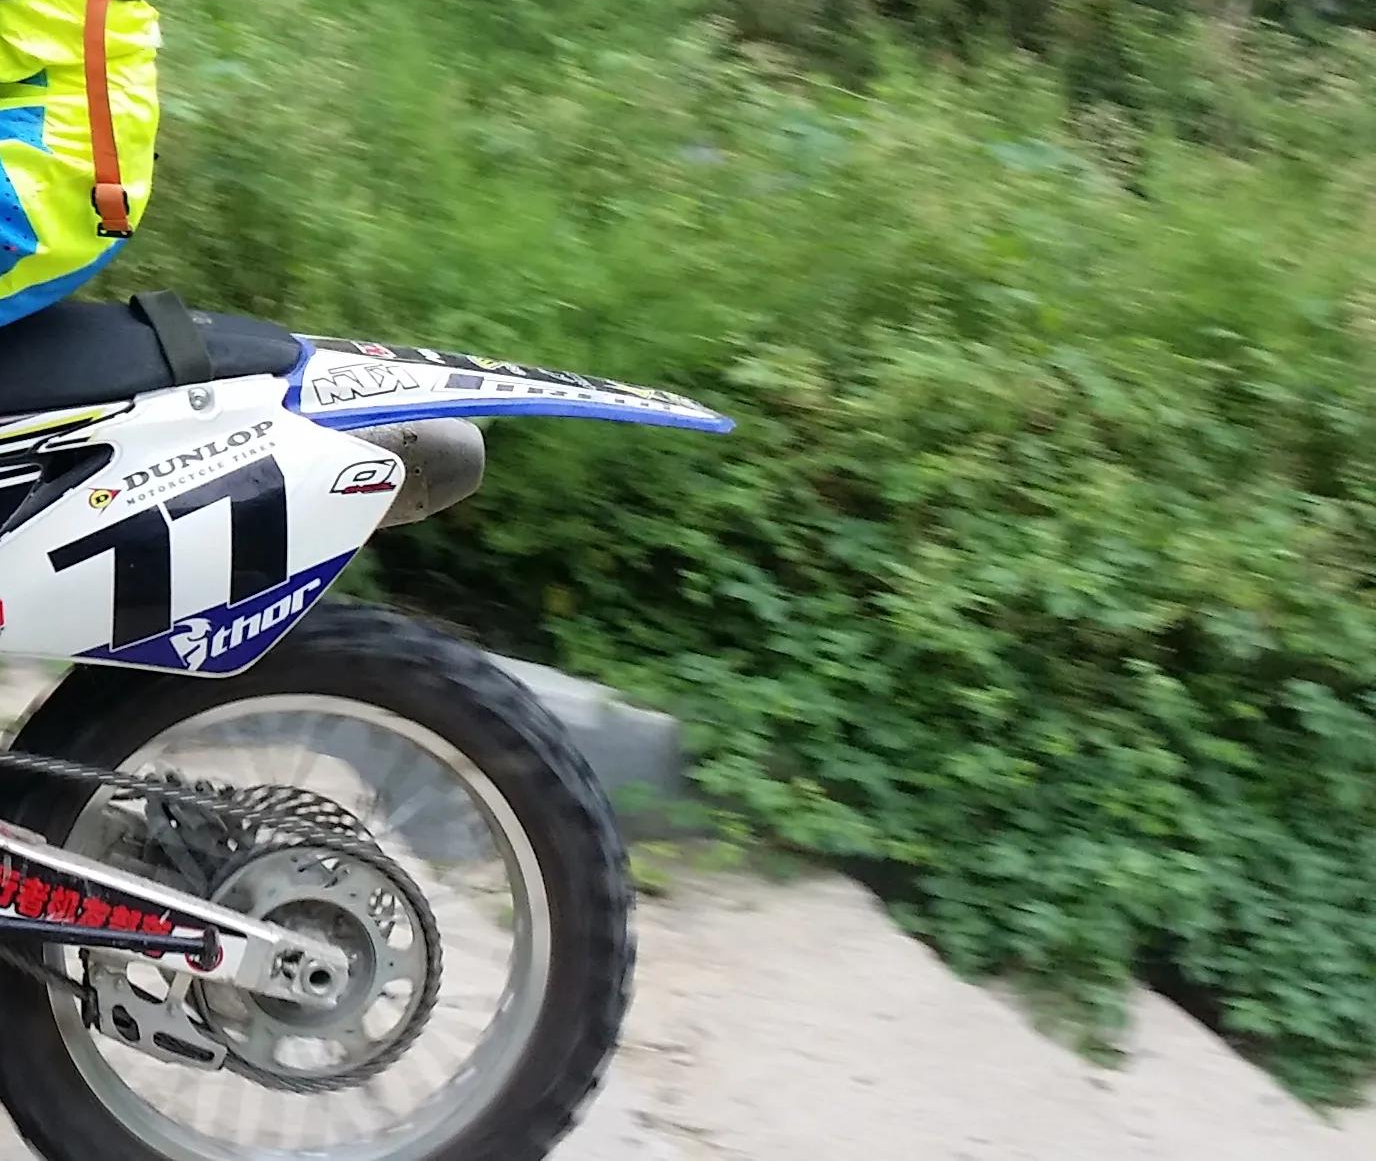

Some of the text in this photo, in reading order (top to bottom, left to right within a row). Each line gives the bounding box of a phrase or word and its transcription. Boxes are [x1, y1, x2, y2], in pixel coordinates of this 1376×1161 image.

[121, 420, 274, 492] DUNLOP
[126, 440, 277, 506] MOTORCYCLE TIRES
[209, 577, 322, 659] thor
